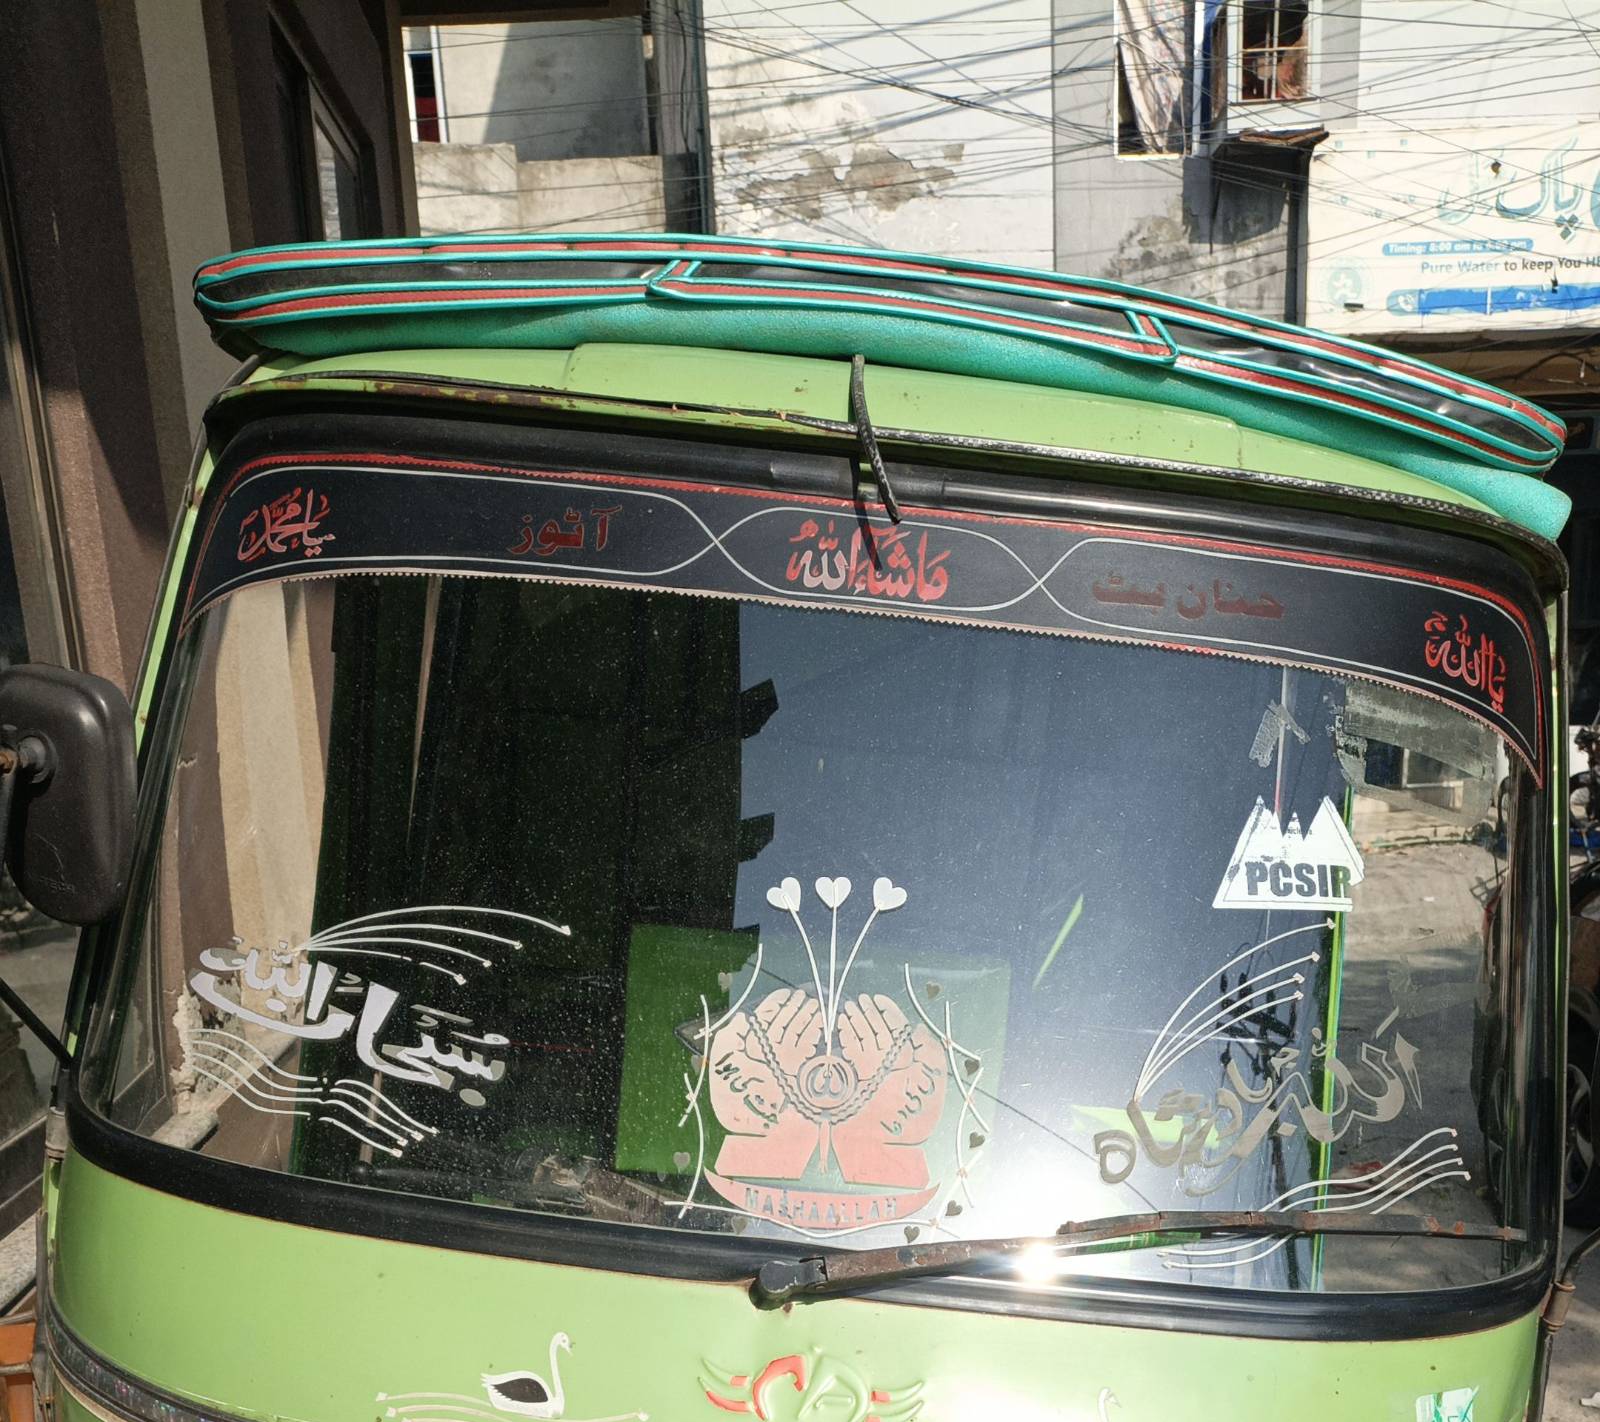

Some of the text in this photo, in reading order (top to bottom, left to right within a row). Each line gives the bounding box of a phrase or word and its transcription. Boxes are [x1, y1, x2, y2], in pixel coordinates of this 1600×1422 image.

[1420, 261, 1453, 273] Pure
[1457, 260, 1500, 273] Water
[1504, 261, 1517, 271] to
[1522, 258, 1553, 272] keep
[1557, 257, 1581, 269] You
[1245, 860, 1351, 898] PCSIR
